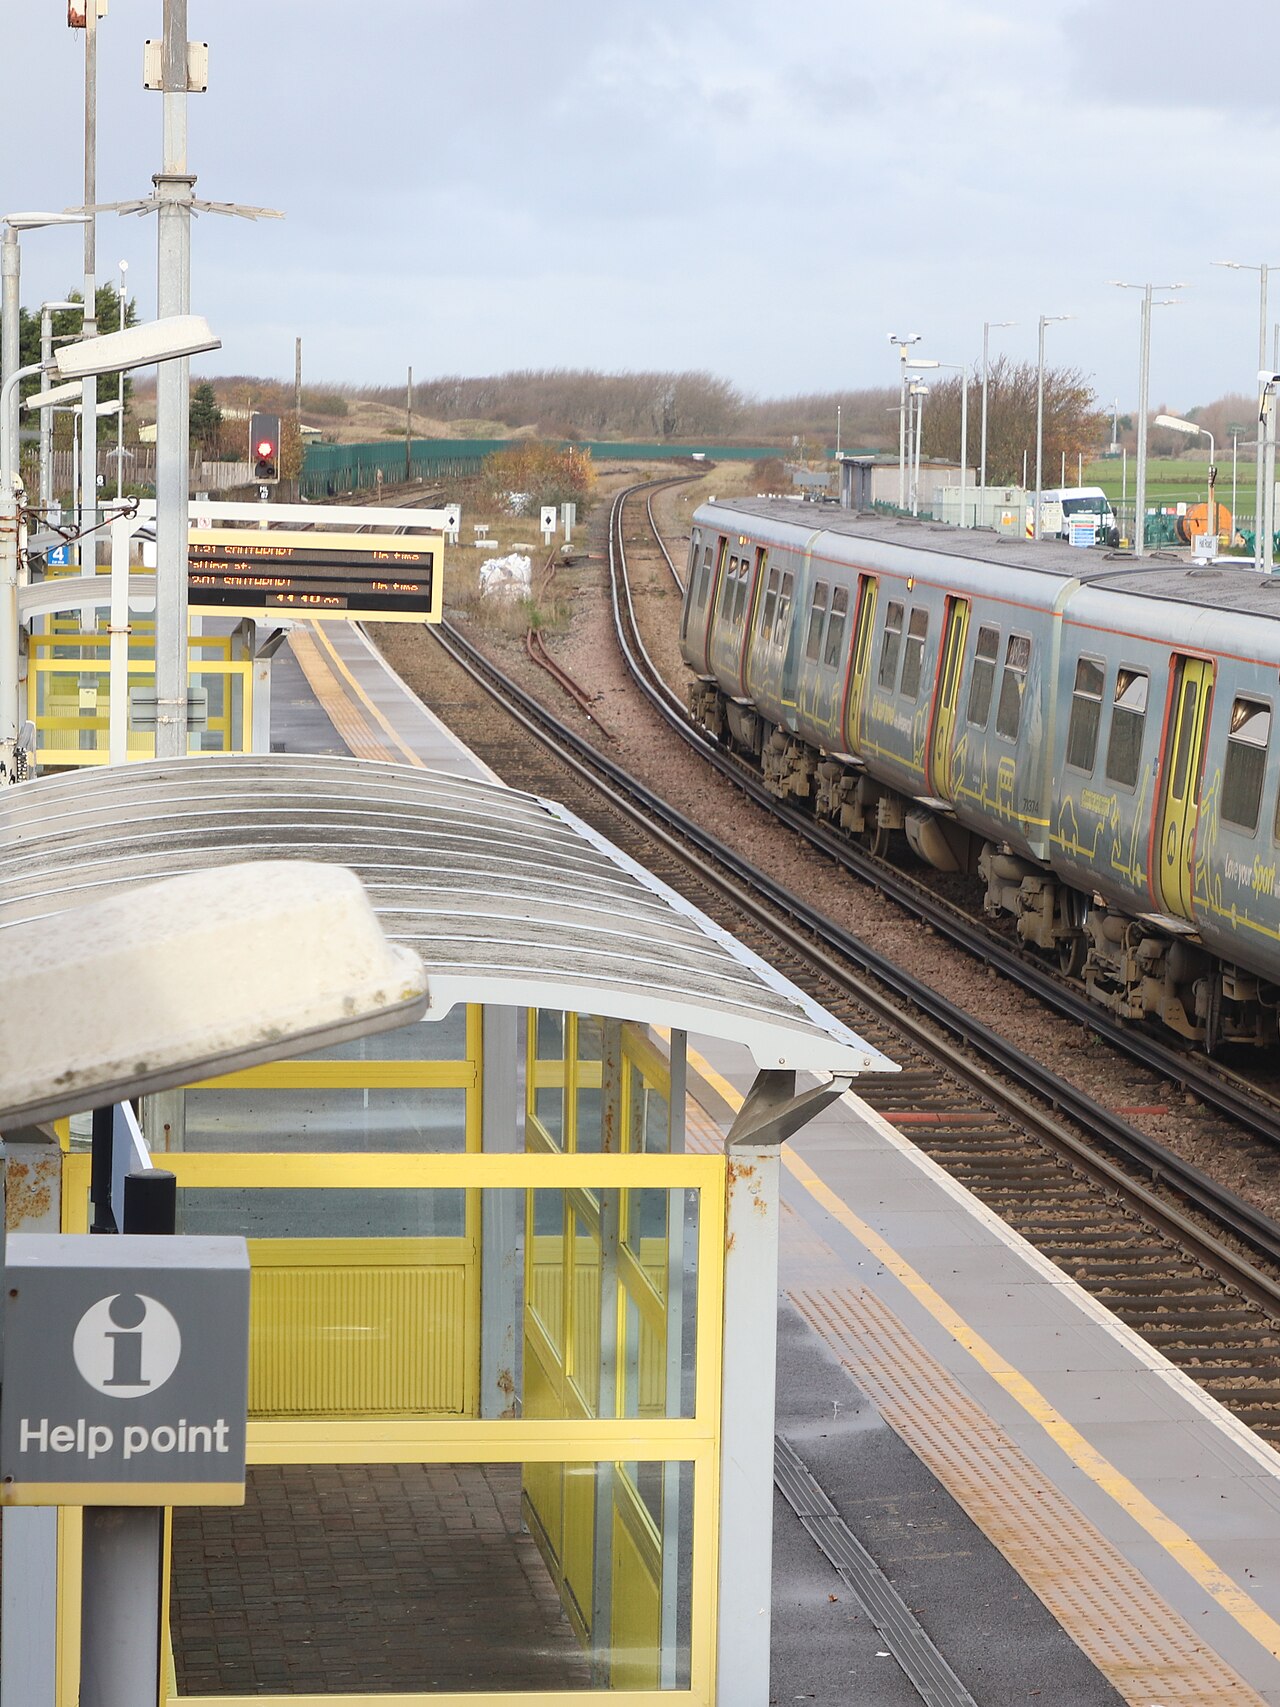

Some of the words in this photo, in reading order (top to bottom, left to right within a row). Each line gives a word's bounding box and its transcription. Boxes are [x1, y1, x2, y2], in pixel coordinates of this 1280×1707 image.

[52, 546, 65, 561] 4
[1224, 852, 1238, 881] Love
[1238, 864, 1253, 891] your
[1252, 854, 1276, 900] Sport
[19, 1417, 114, 1460] Help
[123, 1417, 230, 1460] point
